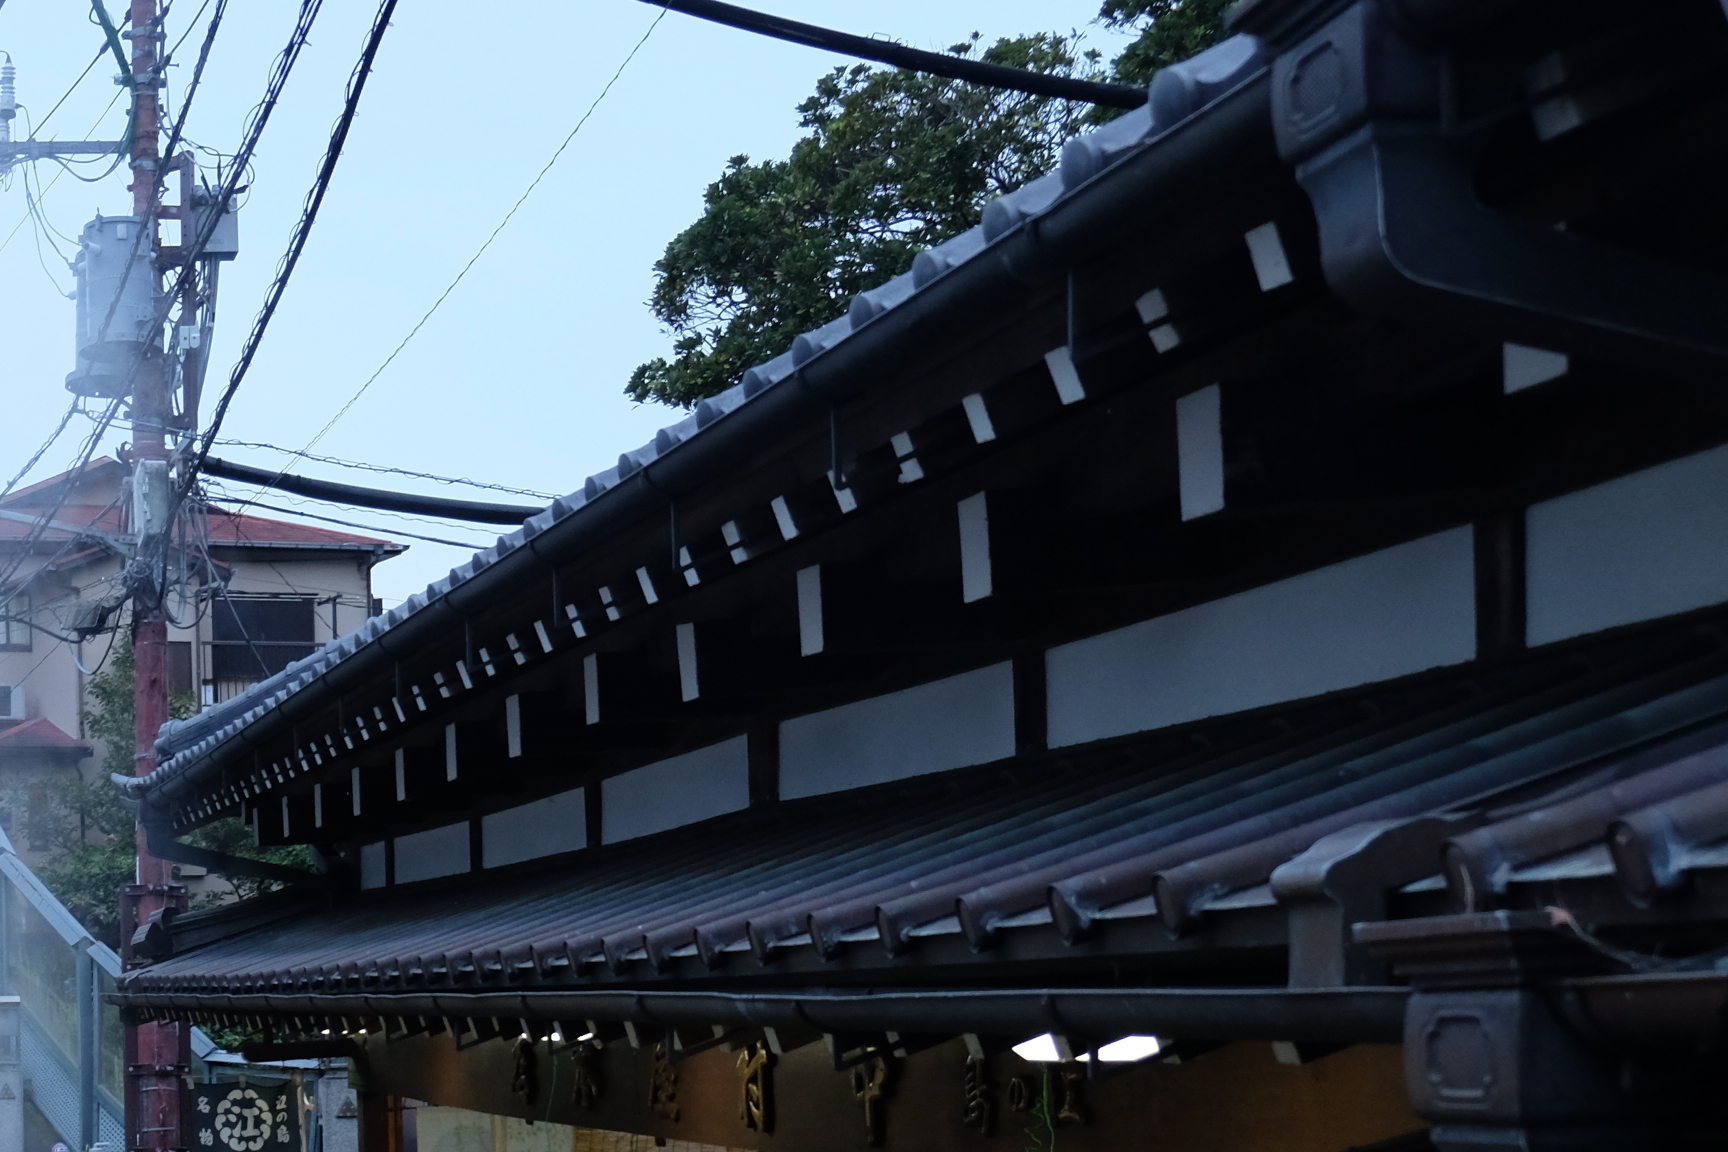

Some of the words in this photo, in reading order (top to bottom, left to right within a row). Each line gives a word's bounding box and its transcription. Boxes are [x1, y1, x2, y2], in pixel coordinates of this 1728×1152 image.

[197, 1096, 214, 1147] 名物
[275, 1095, 290, 1144] 江の島
